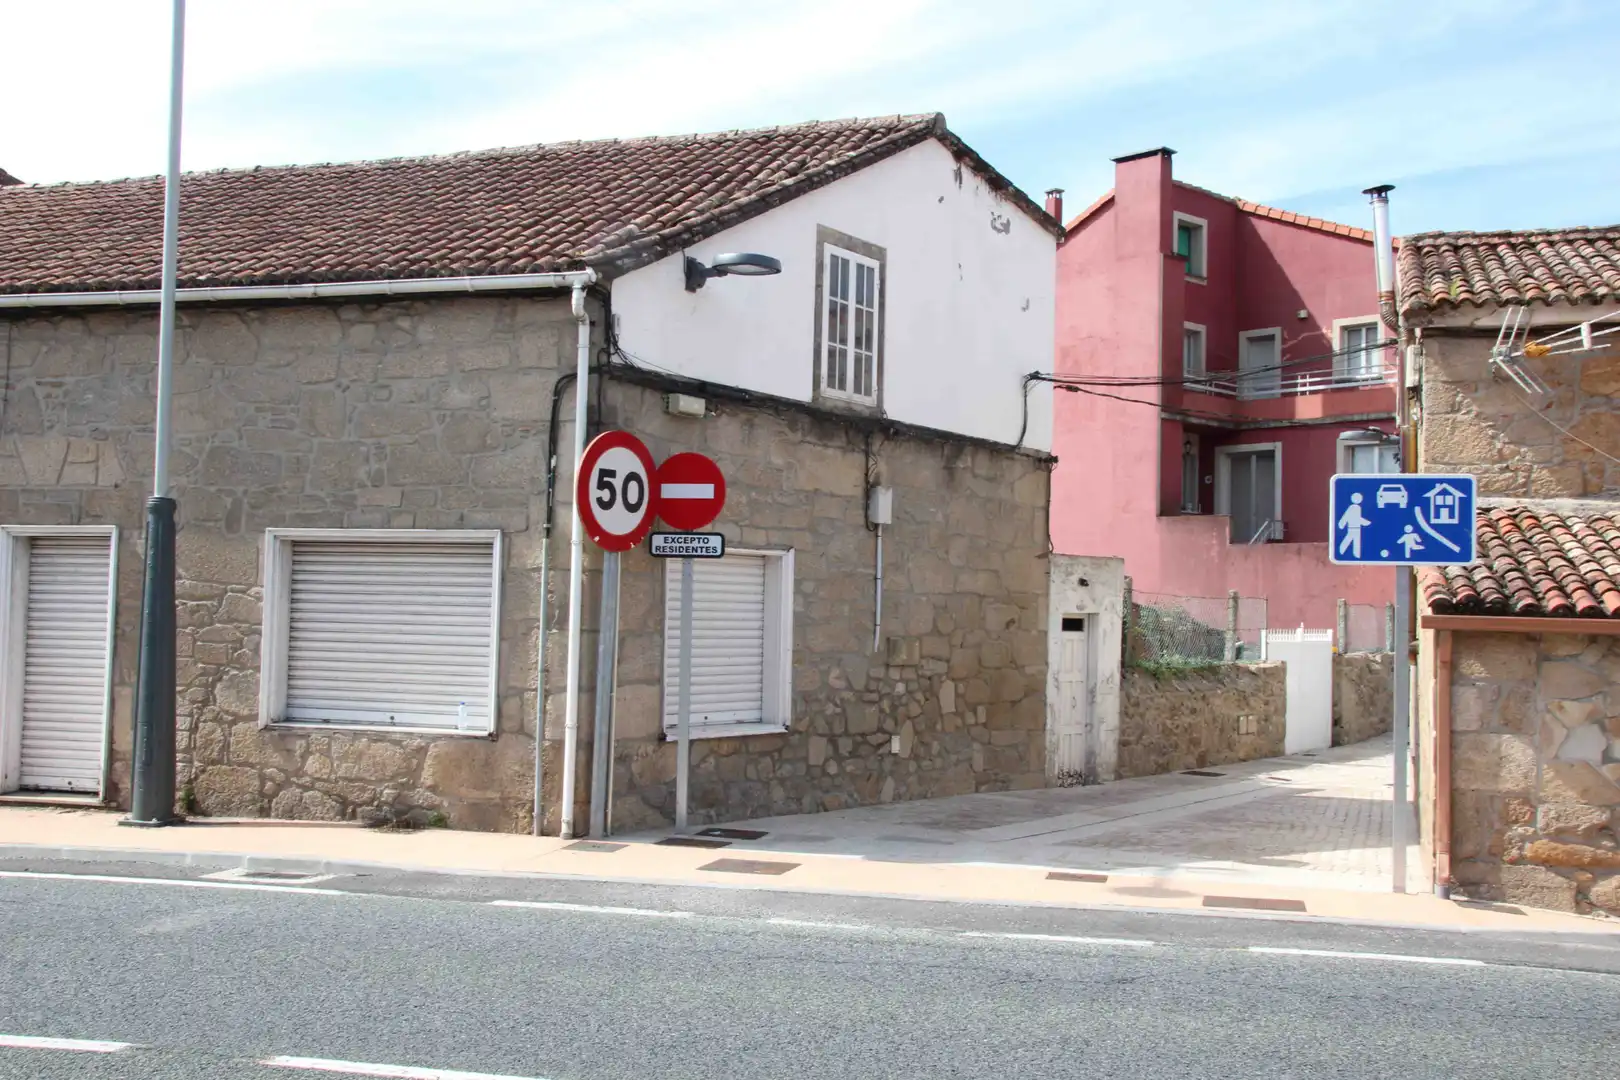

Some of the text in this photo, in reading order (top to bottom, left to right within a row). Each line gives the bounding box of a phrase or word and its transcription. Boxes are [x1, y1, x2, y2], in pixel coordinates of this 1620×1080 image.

[596, 468, 645, 513] 50
[663, 536, 710, 545] EXCEPTO
[655, 545, 718, 554] RESIDENTES
